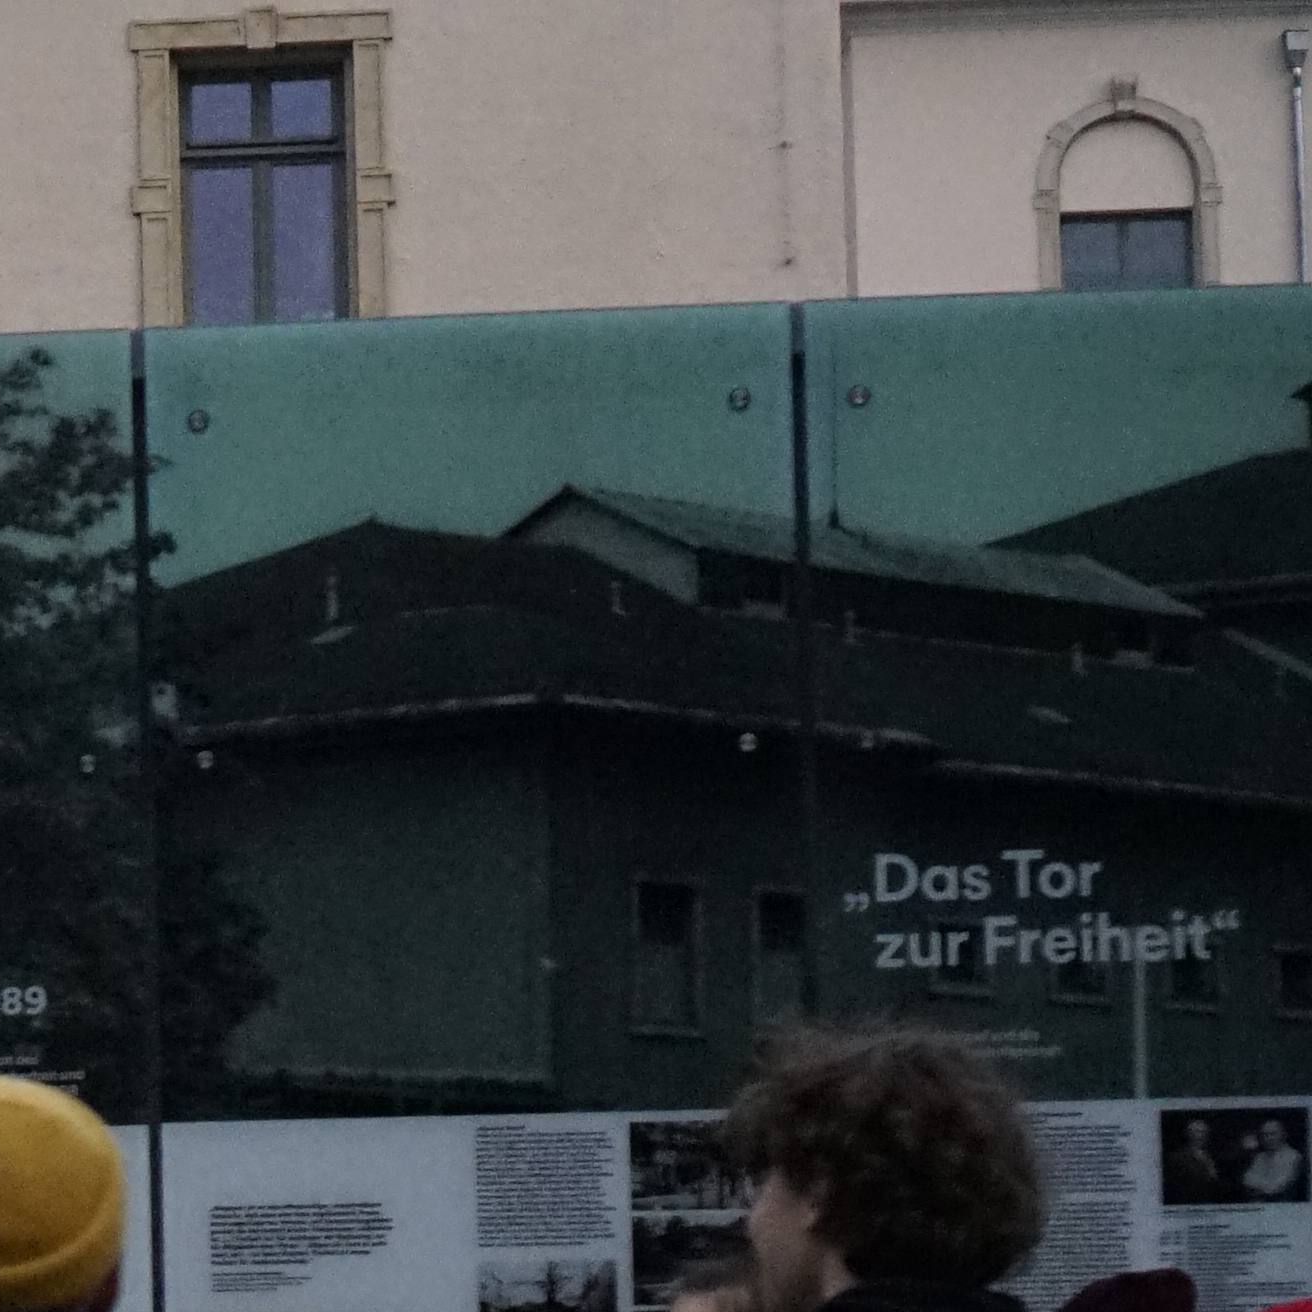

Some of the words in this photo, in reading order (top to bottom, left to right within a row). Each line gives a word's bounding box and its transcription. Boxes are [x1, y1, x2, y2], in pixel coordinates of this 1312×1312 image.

[843, 852, 991, 913] „Das
[1000, 847, 1104, 900] Tor
[875, 926, 970, 969] zur
[982, 908, 1240, 966] Freiheit“
